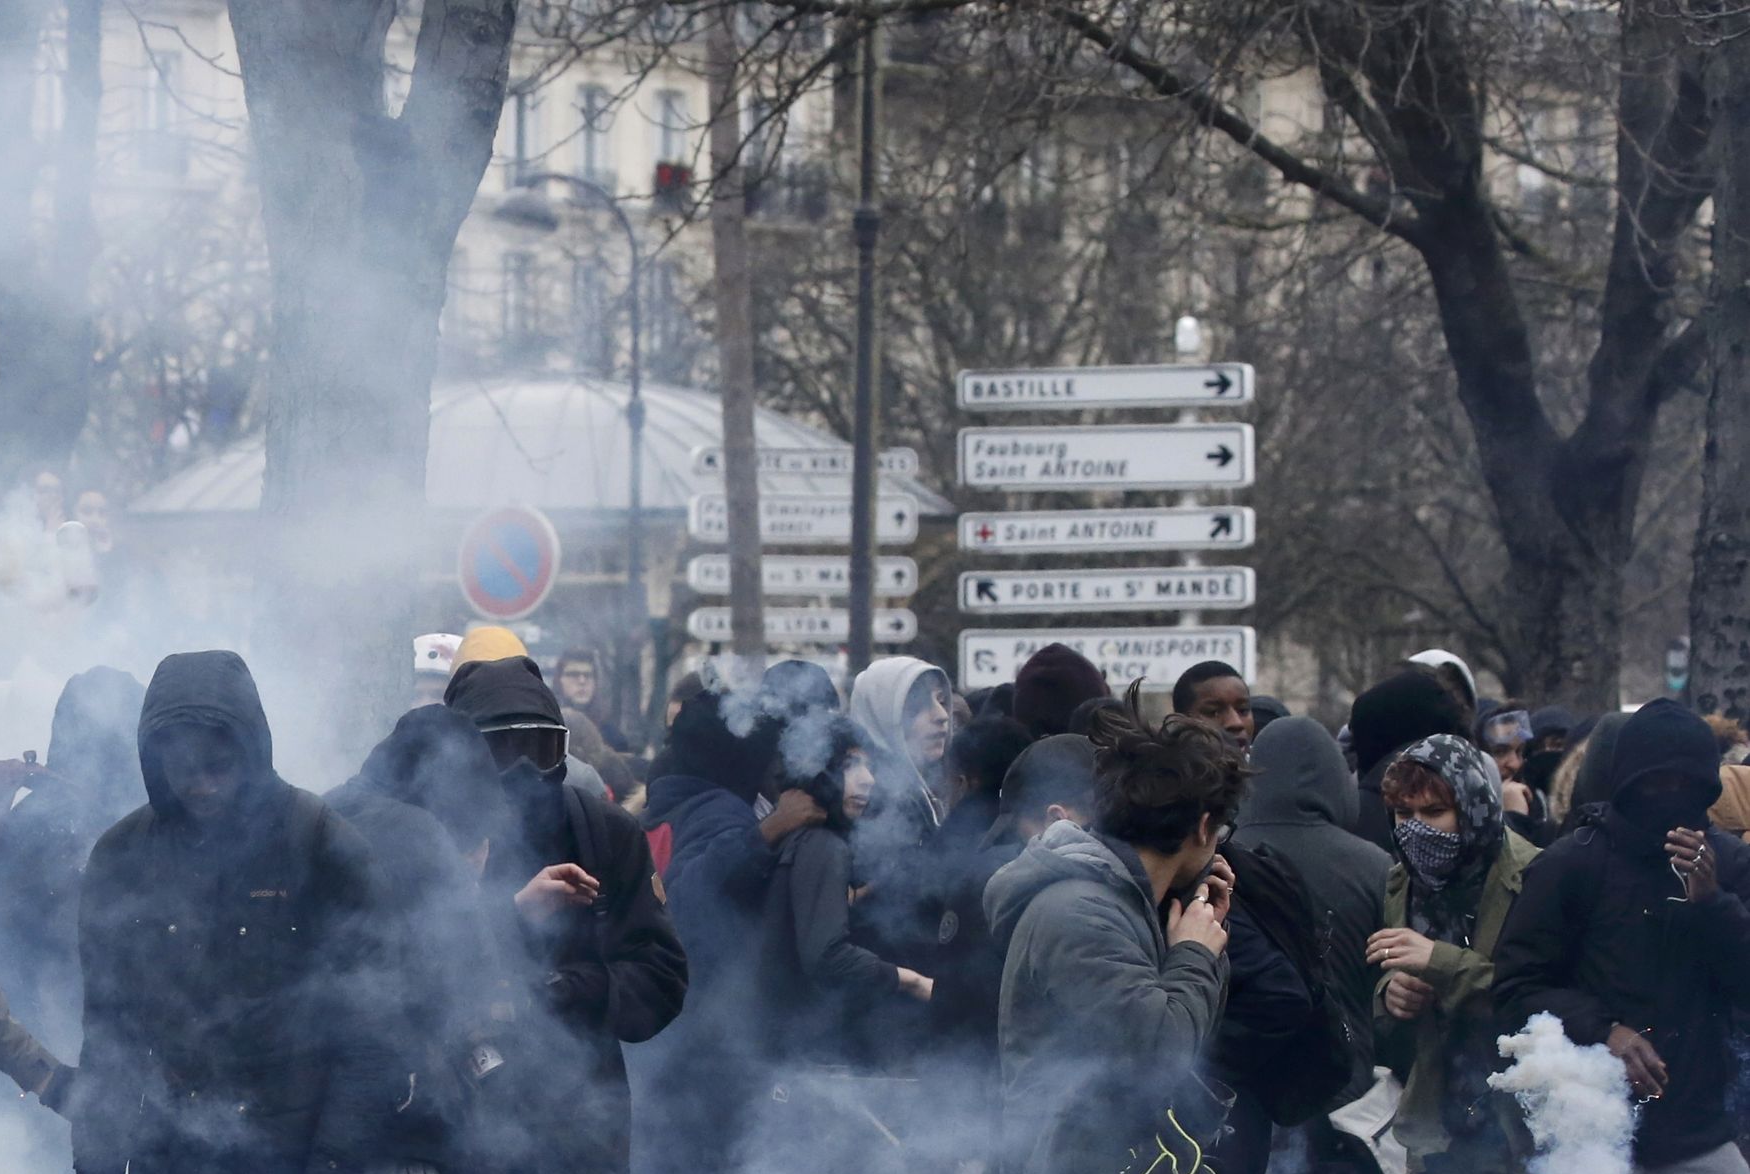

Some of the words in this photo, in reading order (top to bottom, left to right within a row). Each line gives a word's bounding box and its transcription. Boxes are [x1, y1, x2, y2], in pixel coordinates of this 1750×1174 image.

[972, 379, 1076, 398] BASTILLE
[974, 440, 1068, 459] Faubourg
[975, 460, 1026, 478] Saint
[1040, 459, 1129, 477] ANTOINE
[1005, 523, 1057, 541] Saint
[1067, 520, 1157, 538] ANTOINE
[1012, 582, 1081, 598] PORTE
[1156, 574, 1233, 596] MANDÉ
